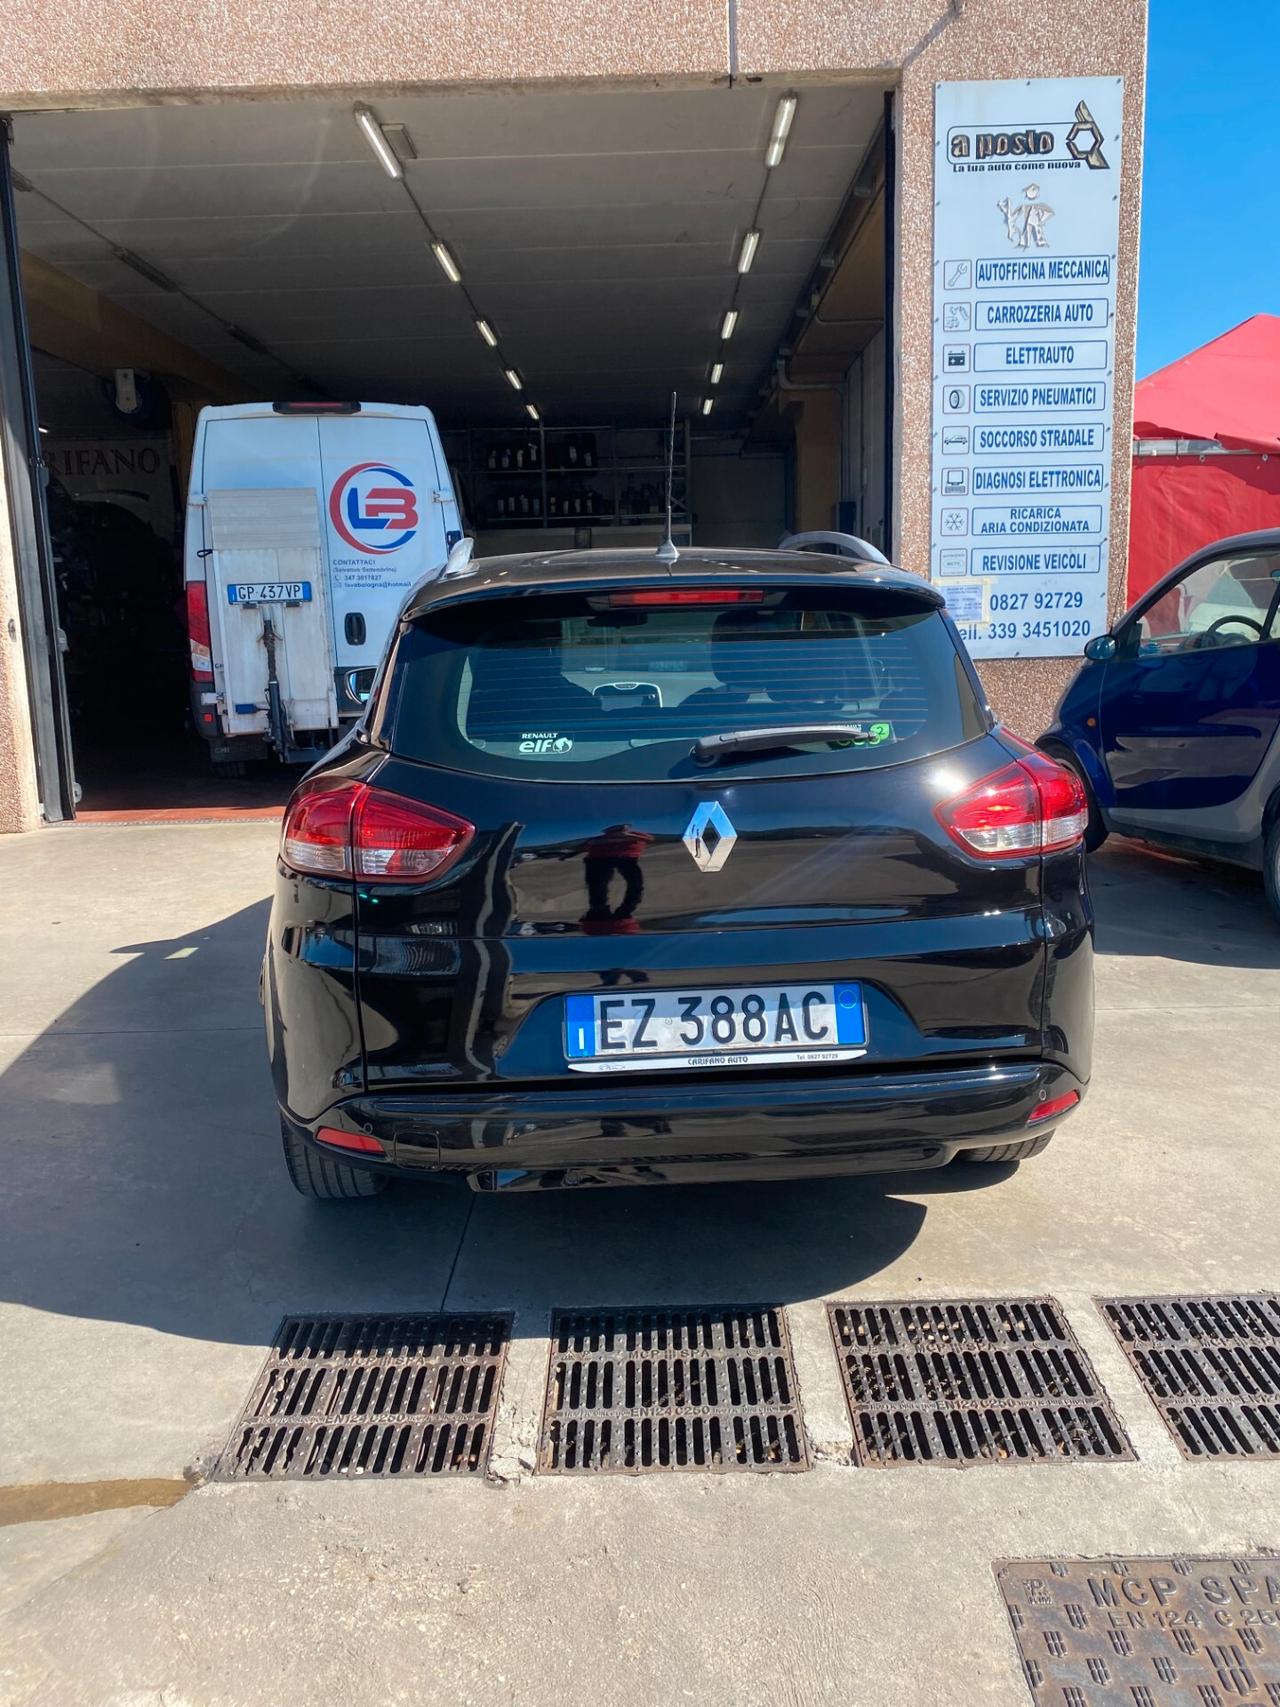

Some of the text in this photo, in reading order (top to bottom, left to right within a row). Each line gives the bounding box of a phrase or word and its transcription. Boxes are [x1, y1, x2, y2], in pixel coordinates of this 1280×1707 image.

[951, 129, 1055, 160] a posto
[953, 160, 1081, 173] La tua auto come nuova
[978, 259, 1109, 282] AUTOFFICINA MECCANICA
[987, 303, 1093, 324] CARROZZERIA AUTO
[1005, 346, 1074, 365] ELETTRAUTO
[979, 387, 1096, 407] SERVIZIO PNEUMATICI
[980, 428, 1094, 448] SOCCORSO STRADALE
[975, 469, 1101, 489] DIAGNOSI ELETTRONICA
[1010, 507, 1061, 520] RICARICA
[981, 520, 1089, 534] ARIA CONDIZIONATA
[982, 553, 1086, 571] REVISIONE VEICOLI
[238, 586, 255, 600] GP
[260, 584, 301, 599] 437VP
[989, 593, 1028, 611] 0827
[1034, 591, 1083, 609] 92729
[960, 619, 1091, 641] ell. 339 3451020
[519, 739, 553, 753] elf
[600, 998, 657, 1050] EZ
[678, 991, 828, 1046] 388AC
[688, 1056, 748, 1066] CARIFANO AUTO
[628, 1349, 710, 1359] MCP SPA
[1087, 1577, 1177, 1607] MCP
[1107, 1608, 1280, 1630] EN 124 C 25
